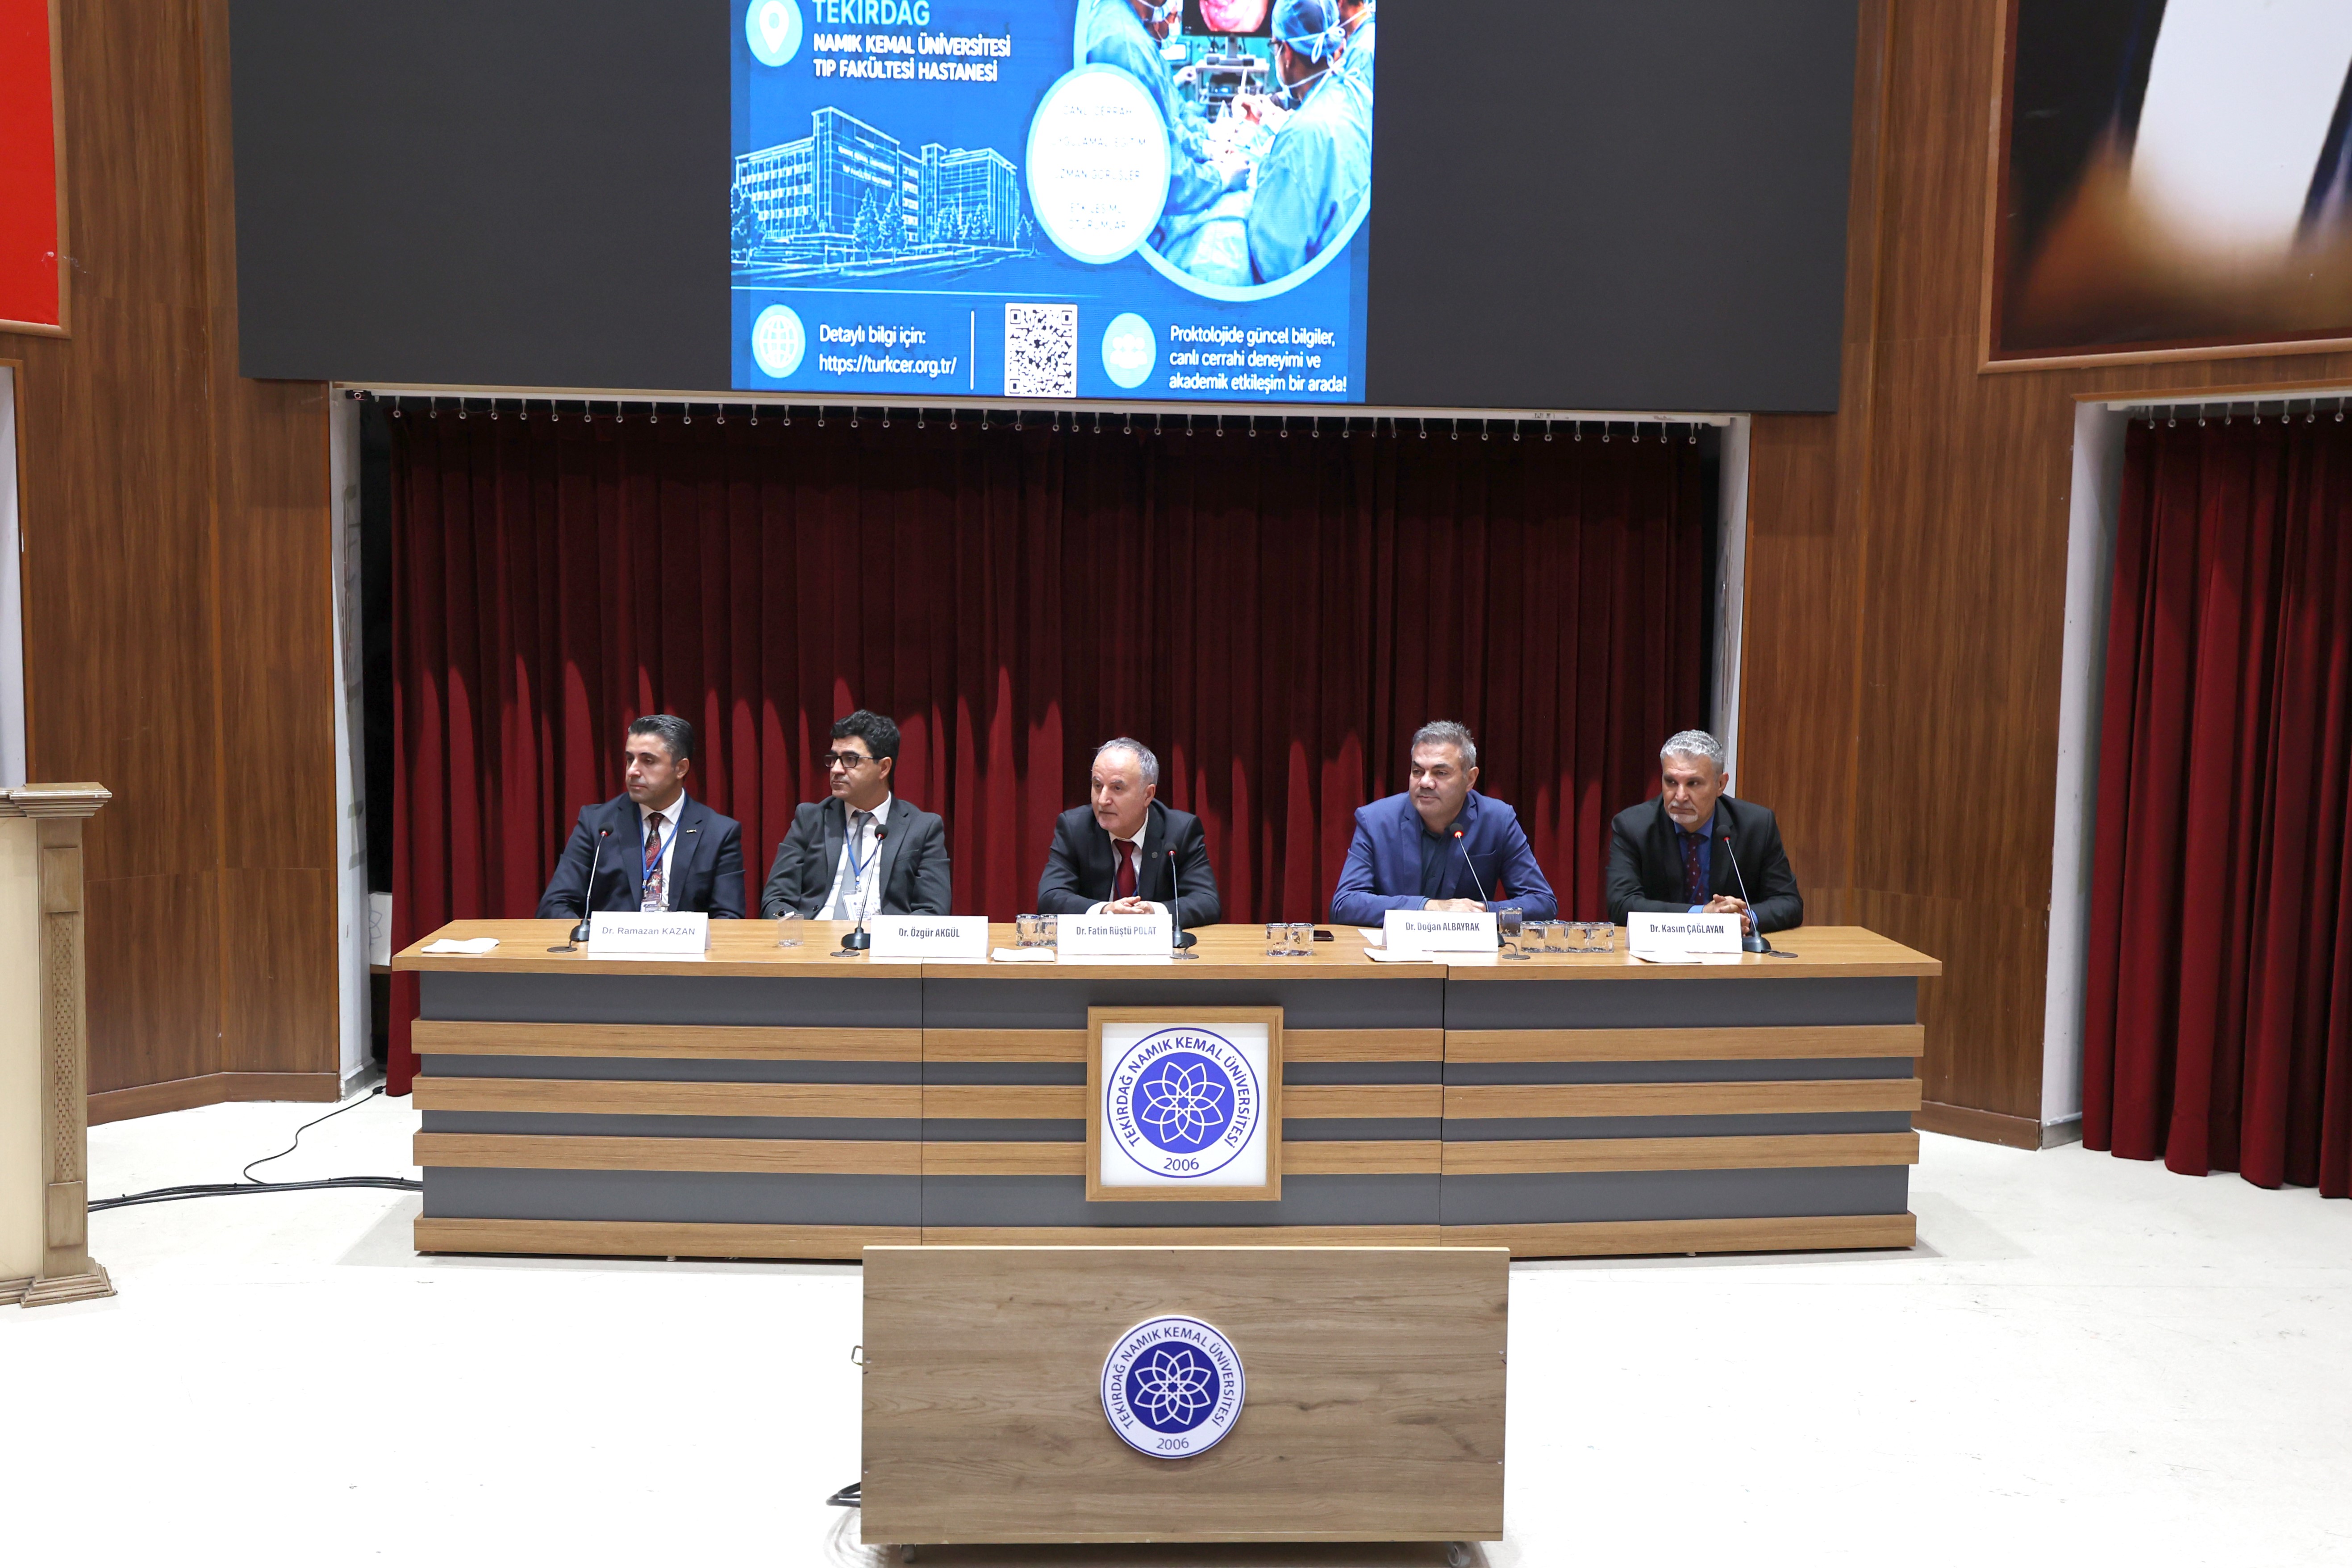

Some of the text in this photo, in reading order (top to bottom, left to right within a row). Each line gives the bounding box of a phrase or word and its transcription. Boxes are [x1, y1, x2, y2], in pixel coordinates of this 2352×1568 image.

[813, 32, 1010, 57] NAMIK KEMAL ÜNİVERSİTESİ
[813, 56, 997, 82] TIP FAKÜLTESİ HASTANESİ
[1063, 105, 1134, 116] CANL CERRAH
[1055, 168, 1087, 179] ZMAN
[820, 324, 926, 348] Detaylı bilgi için:
[1170, 325, 1335, 348] Proktolojide güncel bilgiler,
[819, 354, 957, 378] https://turkcer.org.tr/
[1169, 349, 1321, 371] canlı cerrahi deneyimi ve
[1169, 372, 1347, 394] akademik etkileşim bir arada!
[899, 926, 960, 939] Dr. Özgür AKGÜL
[1076, 926, 1156, 937] Dr. Fatin Rüştü POLAT
[1406, 922, 1480, 932] Dr. Doğan ALBAYRAK
[1650, 923, 1724, 935] Dr. Kasım ÇAĞLAYAN
[1116, 1037, 1251, 1148] TEKİRDAĞ NAMIK KEMAL ÜNİVERSİTESİ
[1163, 1158, 1199, 1171] 2006
[1111, 1327, 1235, 1430] TEKİRDAĞ NAMIK KEMAL ÜNİVERSİTESİ
[1156, 1438, 1189, 1450] 2006
